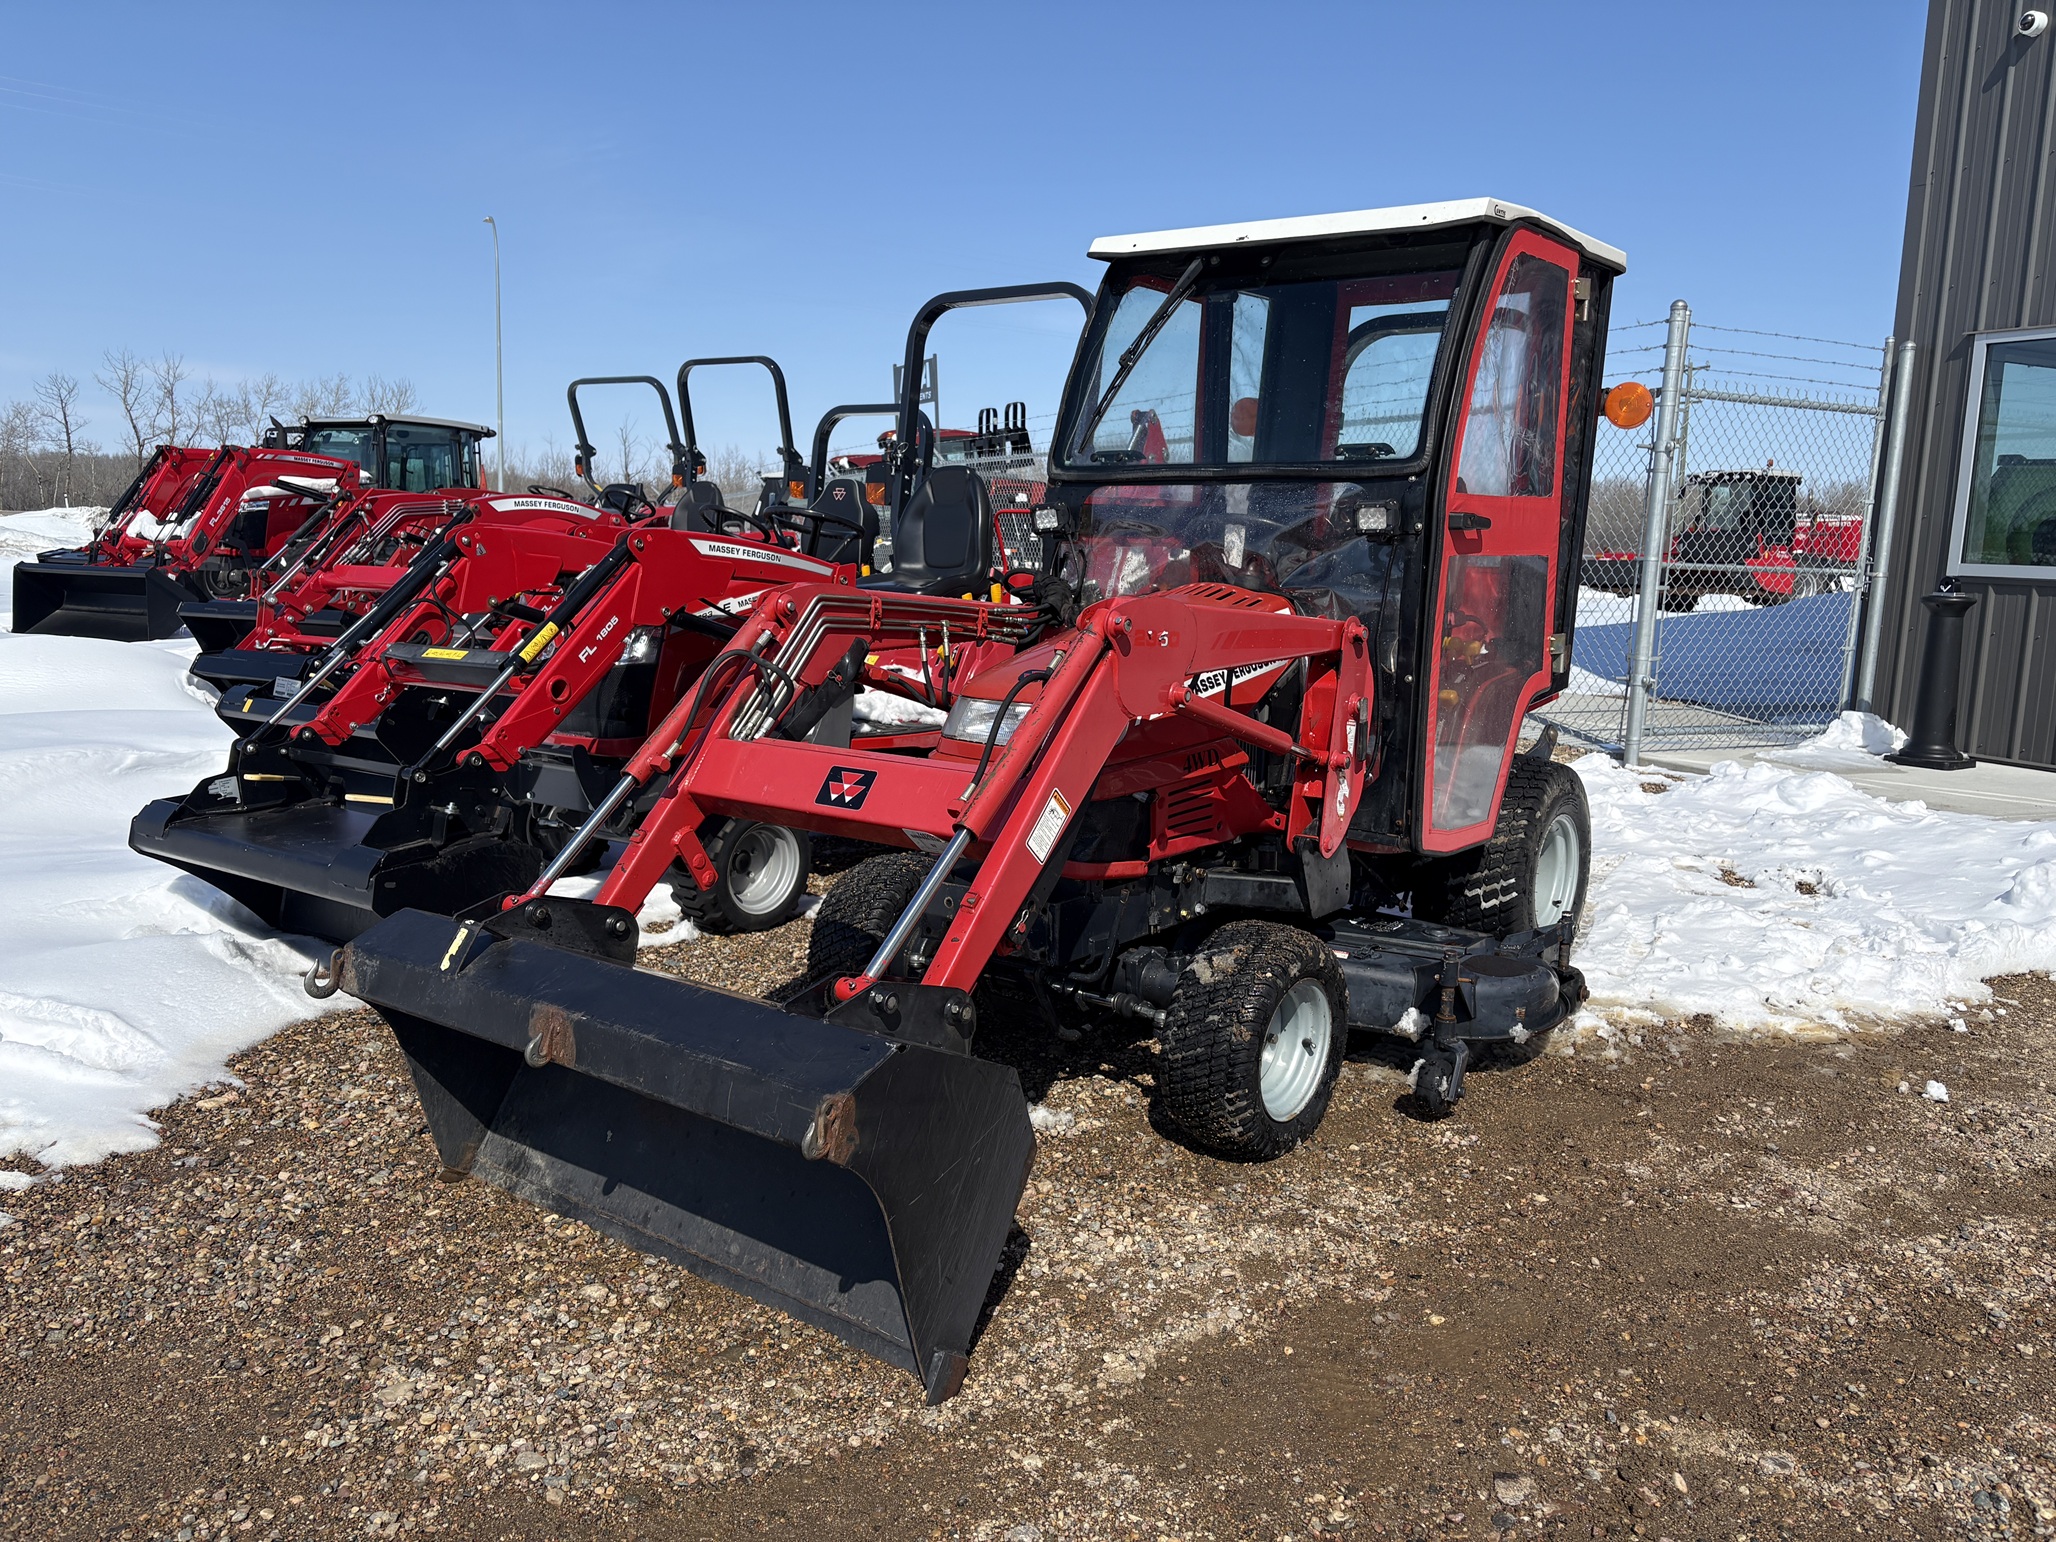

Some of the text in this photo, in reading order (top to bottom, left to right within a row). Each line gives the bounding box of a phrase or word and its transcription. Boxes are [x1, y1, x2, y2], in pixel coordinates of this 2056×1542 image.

[514, 500, 580, 513] MASSEY FERGUSON
[709, 544, 781, 562] MASSEY FERGUSON
[578, 615, 619, 664] FL 1805
[1190, 671, 1227, 695] ASSEY
[1183, 749, 1219, 773] 4WD
